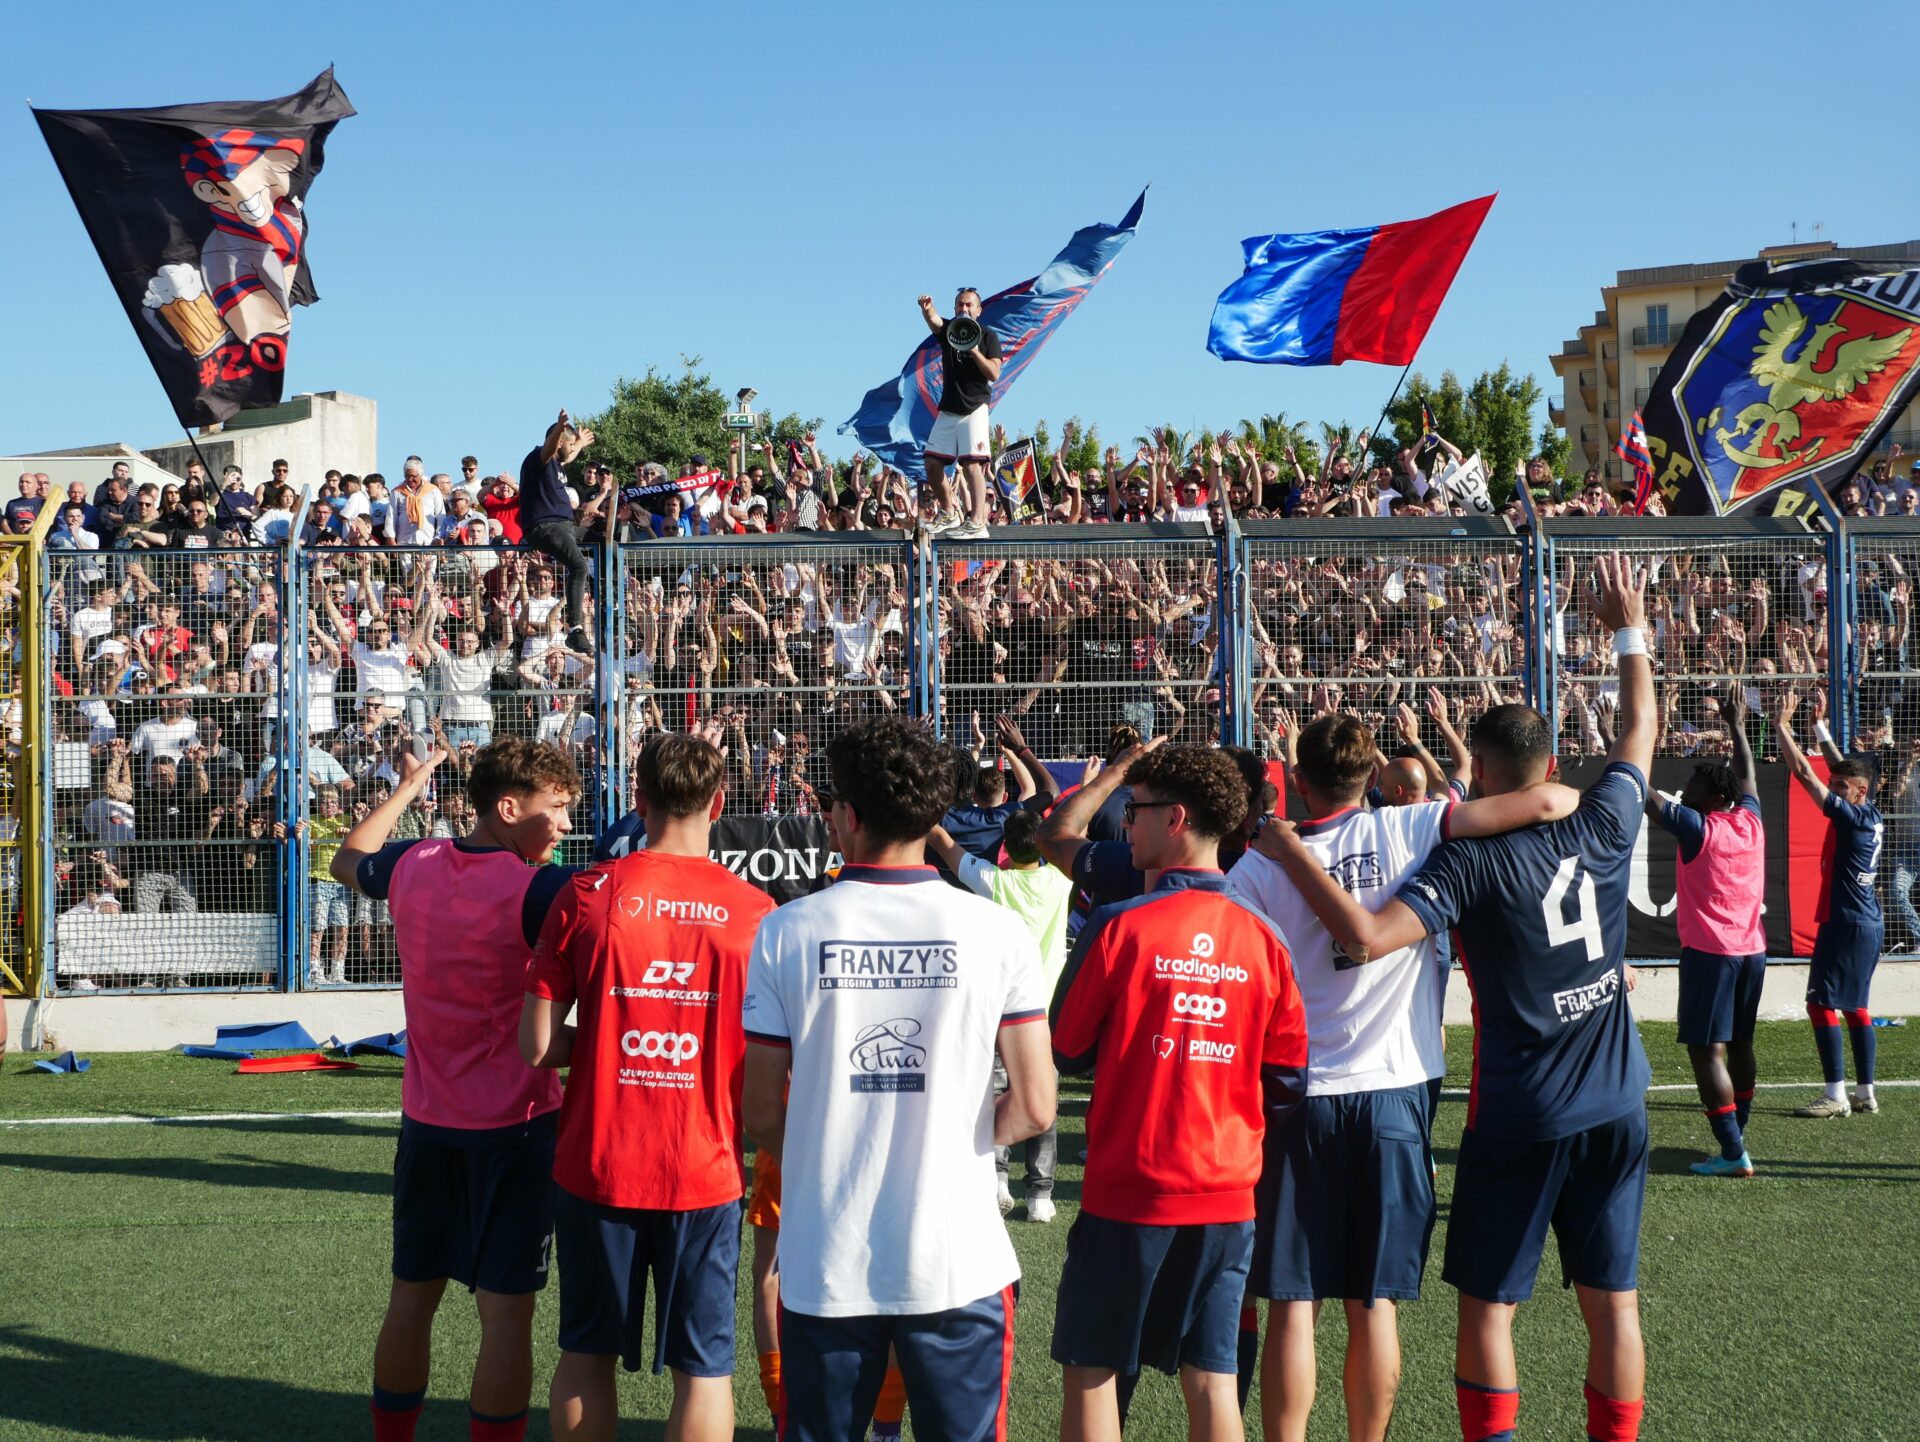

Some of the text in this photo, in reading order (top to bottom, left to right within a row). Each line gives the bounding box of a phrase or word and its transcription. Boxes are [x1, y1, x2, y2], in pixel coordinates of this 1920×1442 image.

[627, 484, 662, 498] SIAMO
[663, 478, 697, 492] PAZZI
[697, 475, 709, 485] DI
[656, 899, 729, 923] PITINO
[1542, 854, 1604, 962] 4
[819, 940, 957, 974] FRANZY'S
[1155, 955, 1248, 983] tradinglab
[642, 960, 697, 985] DR
[821, 977, 956, 988] LA REGINA DEL RISPARMIO
[1174, 992, 1226, 1021] coop
[621, 1029, 699, 1066] coop
[858, 1042, 923, 1072] Etna
